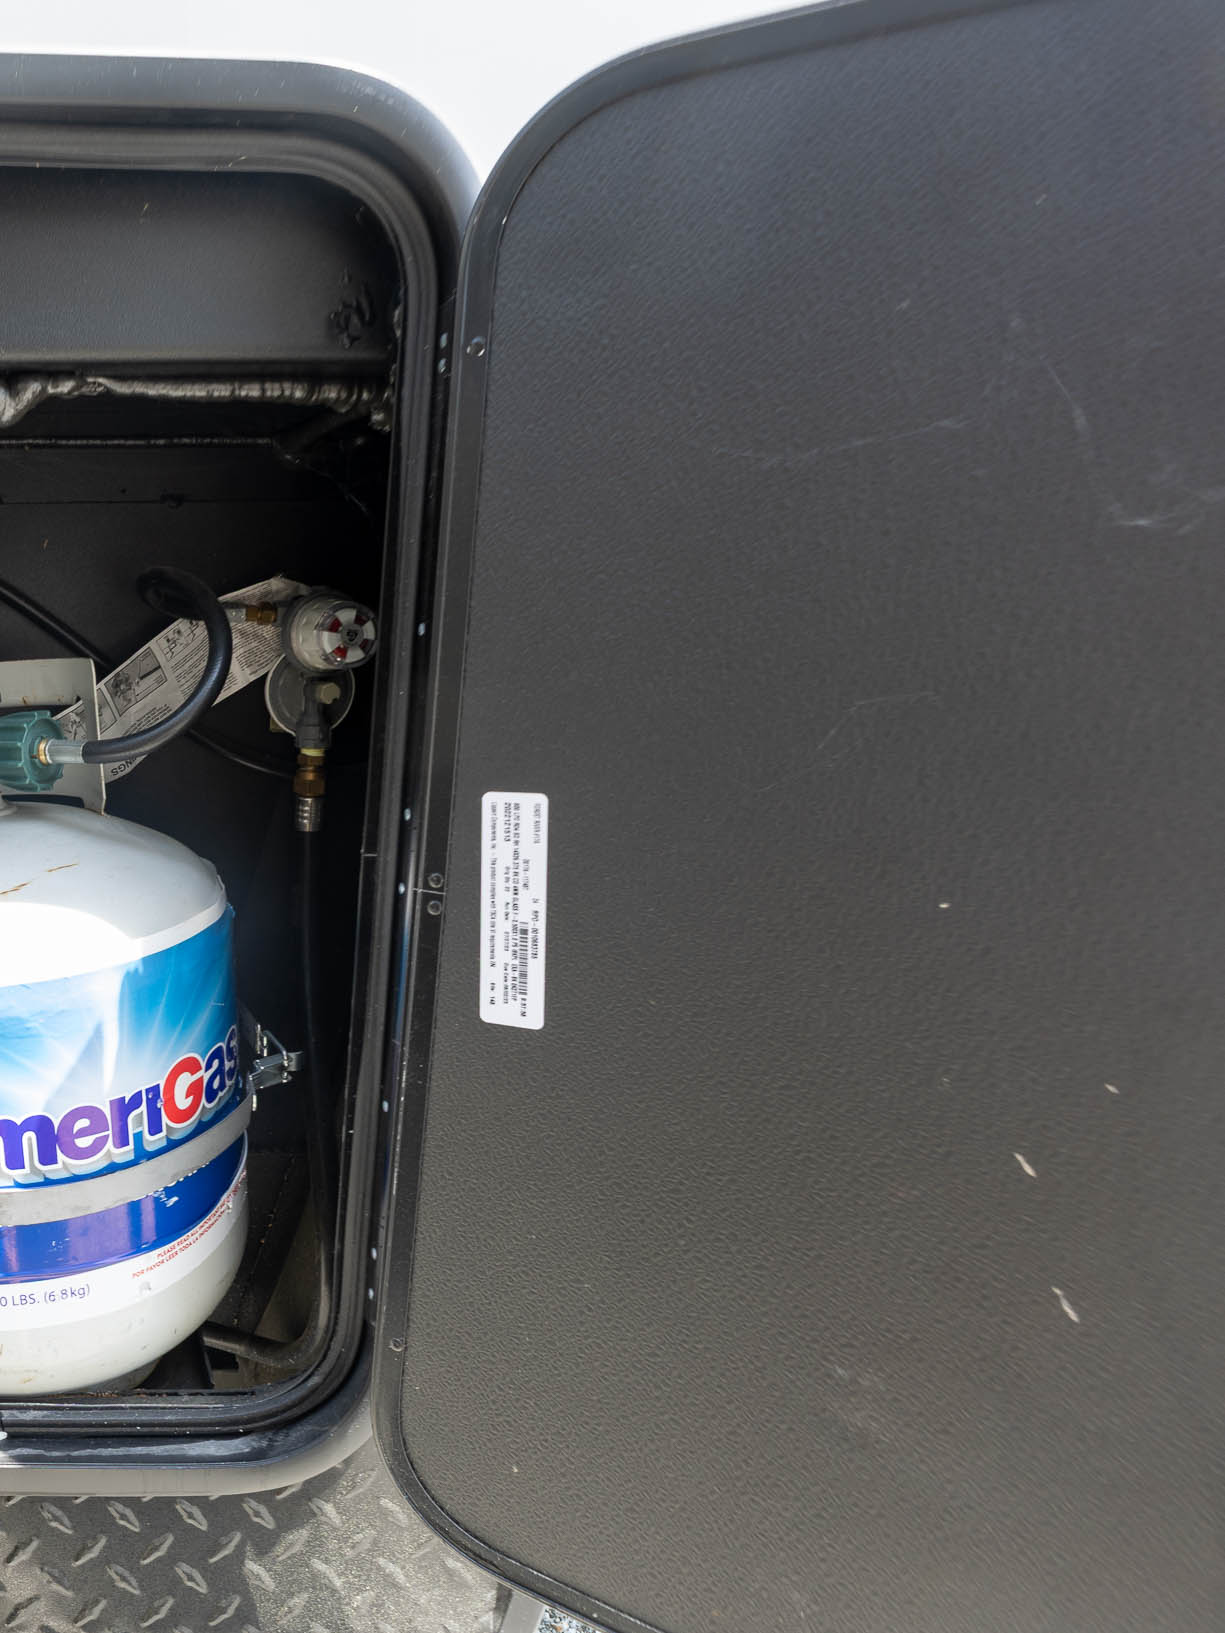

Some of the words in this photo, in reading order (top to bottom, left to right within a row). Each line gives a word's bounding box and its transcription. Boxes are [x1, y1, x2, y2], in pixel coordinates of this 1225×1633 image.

[157, 1244, 176, 1259] PLEASE
[177, 1234, 190, 1246] READ
[132, 1268, 145, 1278] POR
[146, 1259, 165, 1272] FAVOR
[166, 1250, 179, 1262] LEER
[12, 1293, 41, 1307] LBS.
[43, 1283, 91, 1304] (68kg)
